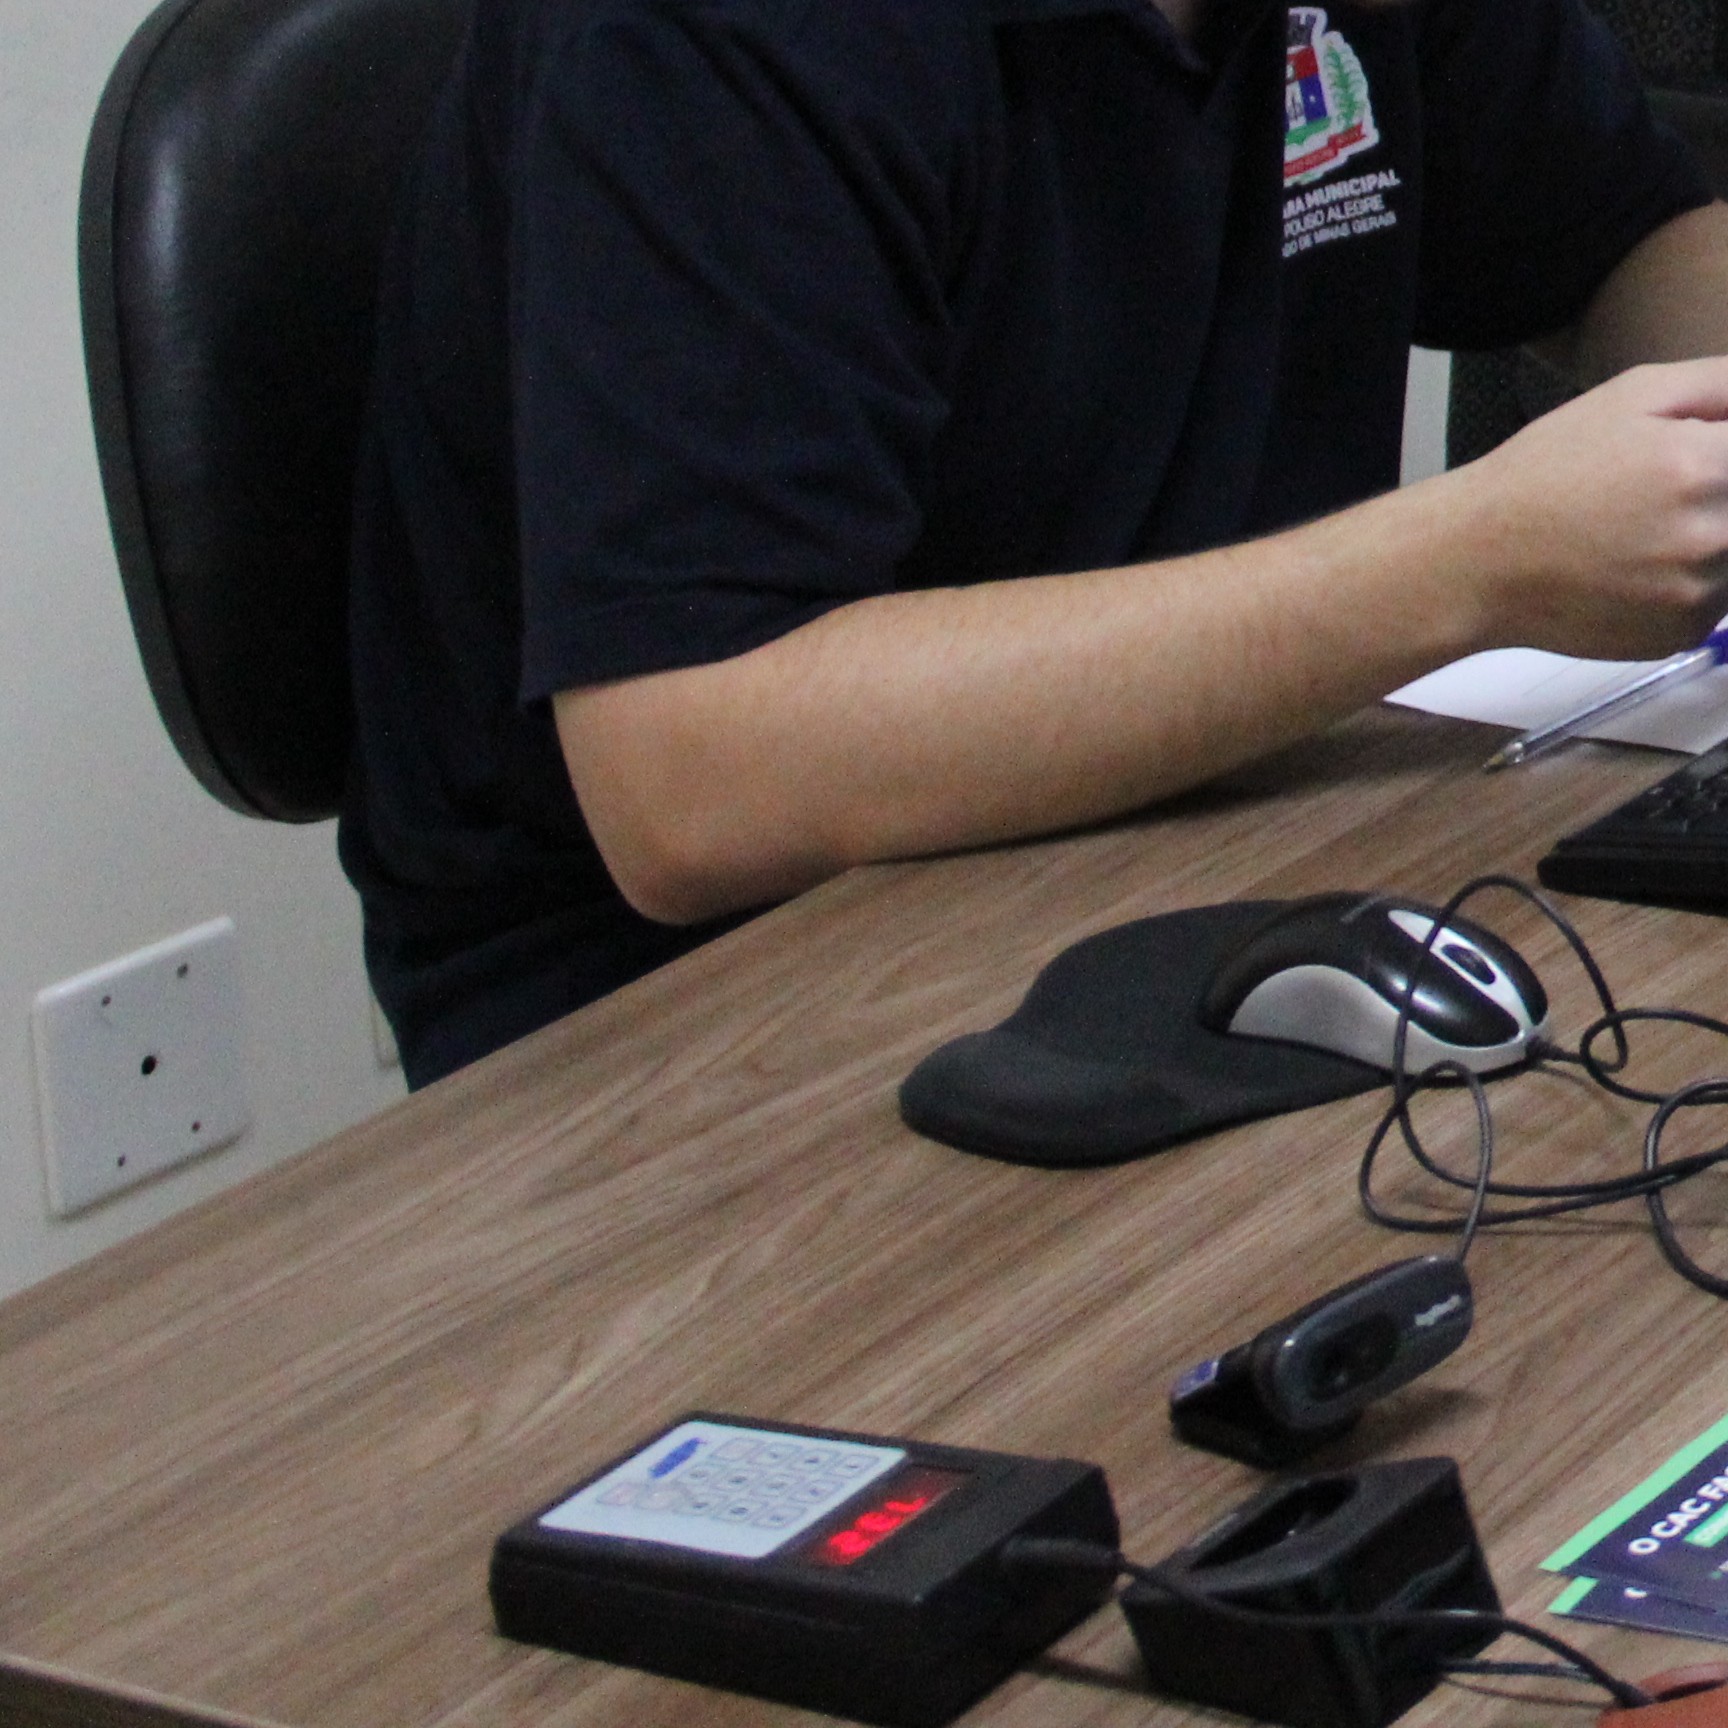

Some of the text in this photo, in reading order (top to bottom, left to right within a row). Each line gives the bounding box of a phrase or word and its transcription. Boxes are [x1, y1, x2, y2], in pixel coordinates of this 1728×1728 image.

[1305, 169, 1401, 208] MUNICIPAL
[1628, 1536, 1661, 1556] O
[1650, 1497, 1710, 1539] CAC
